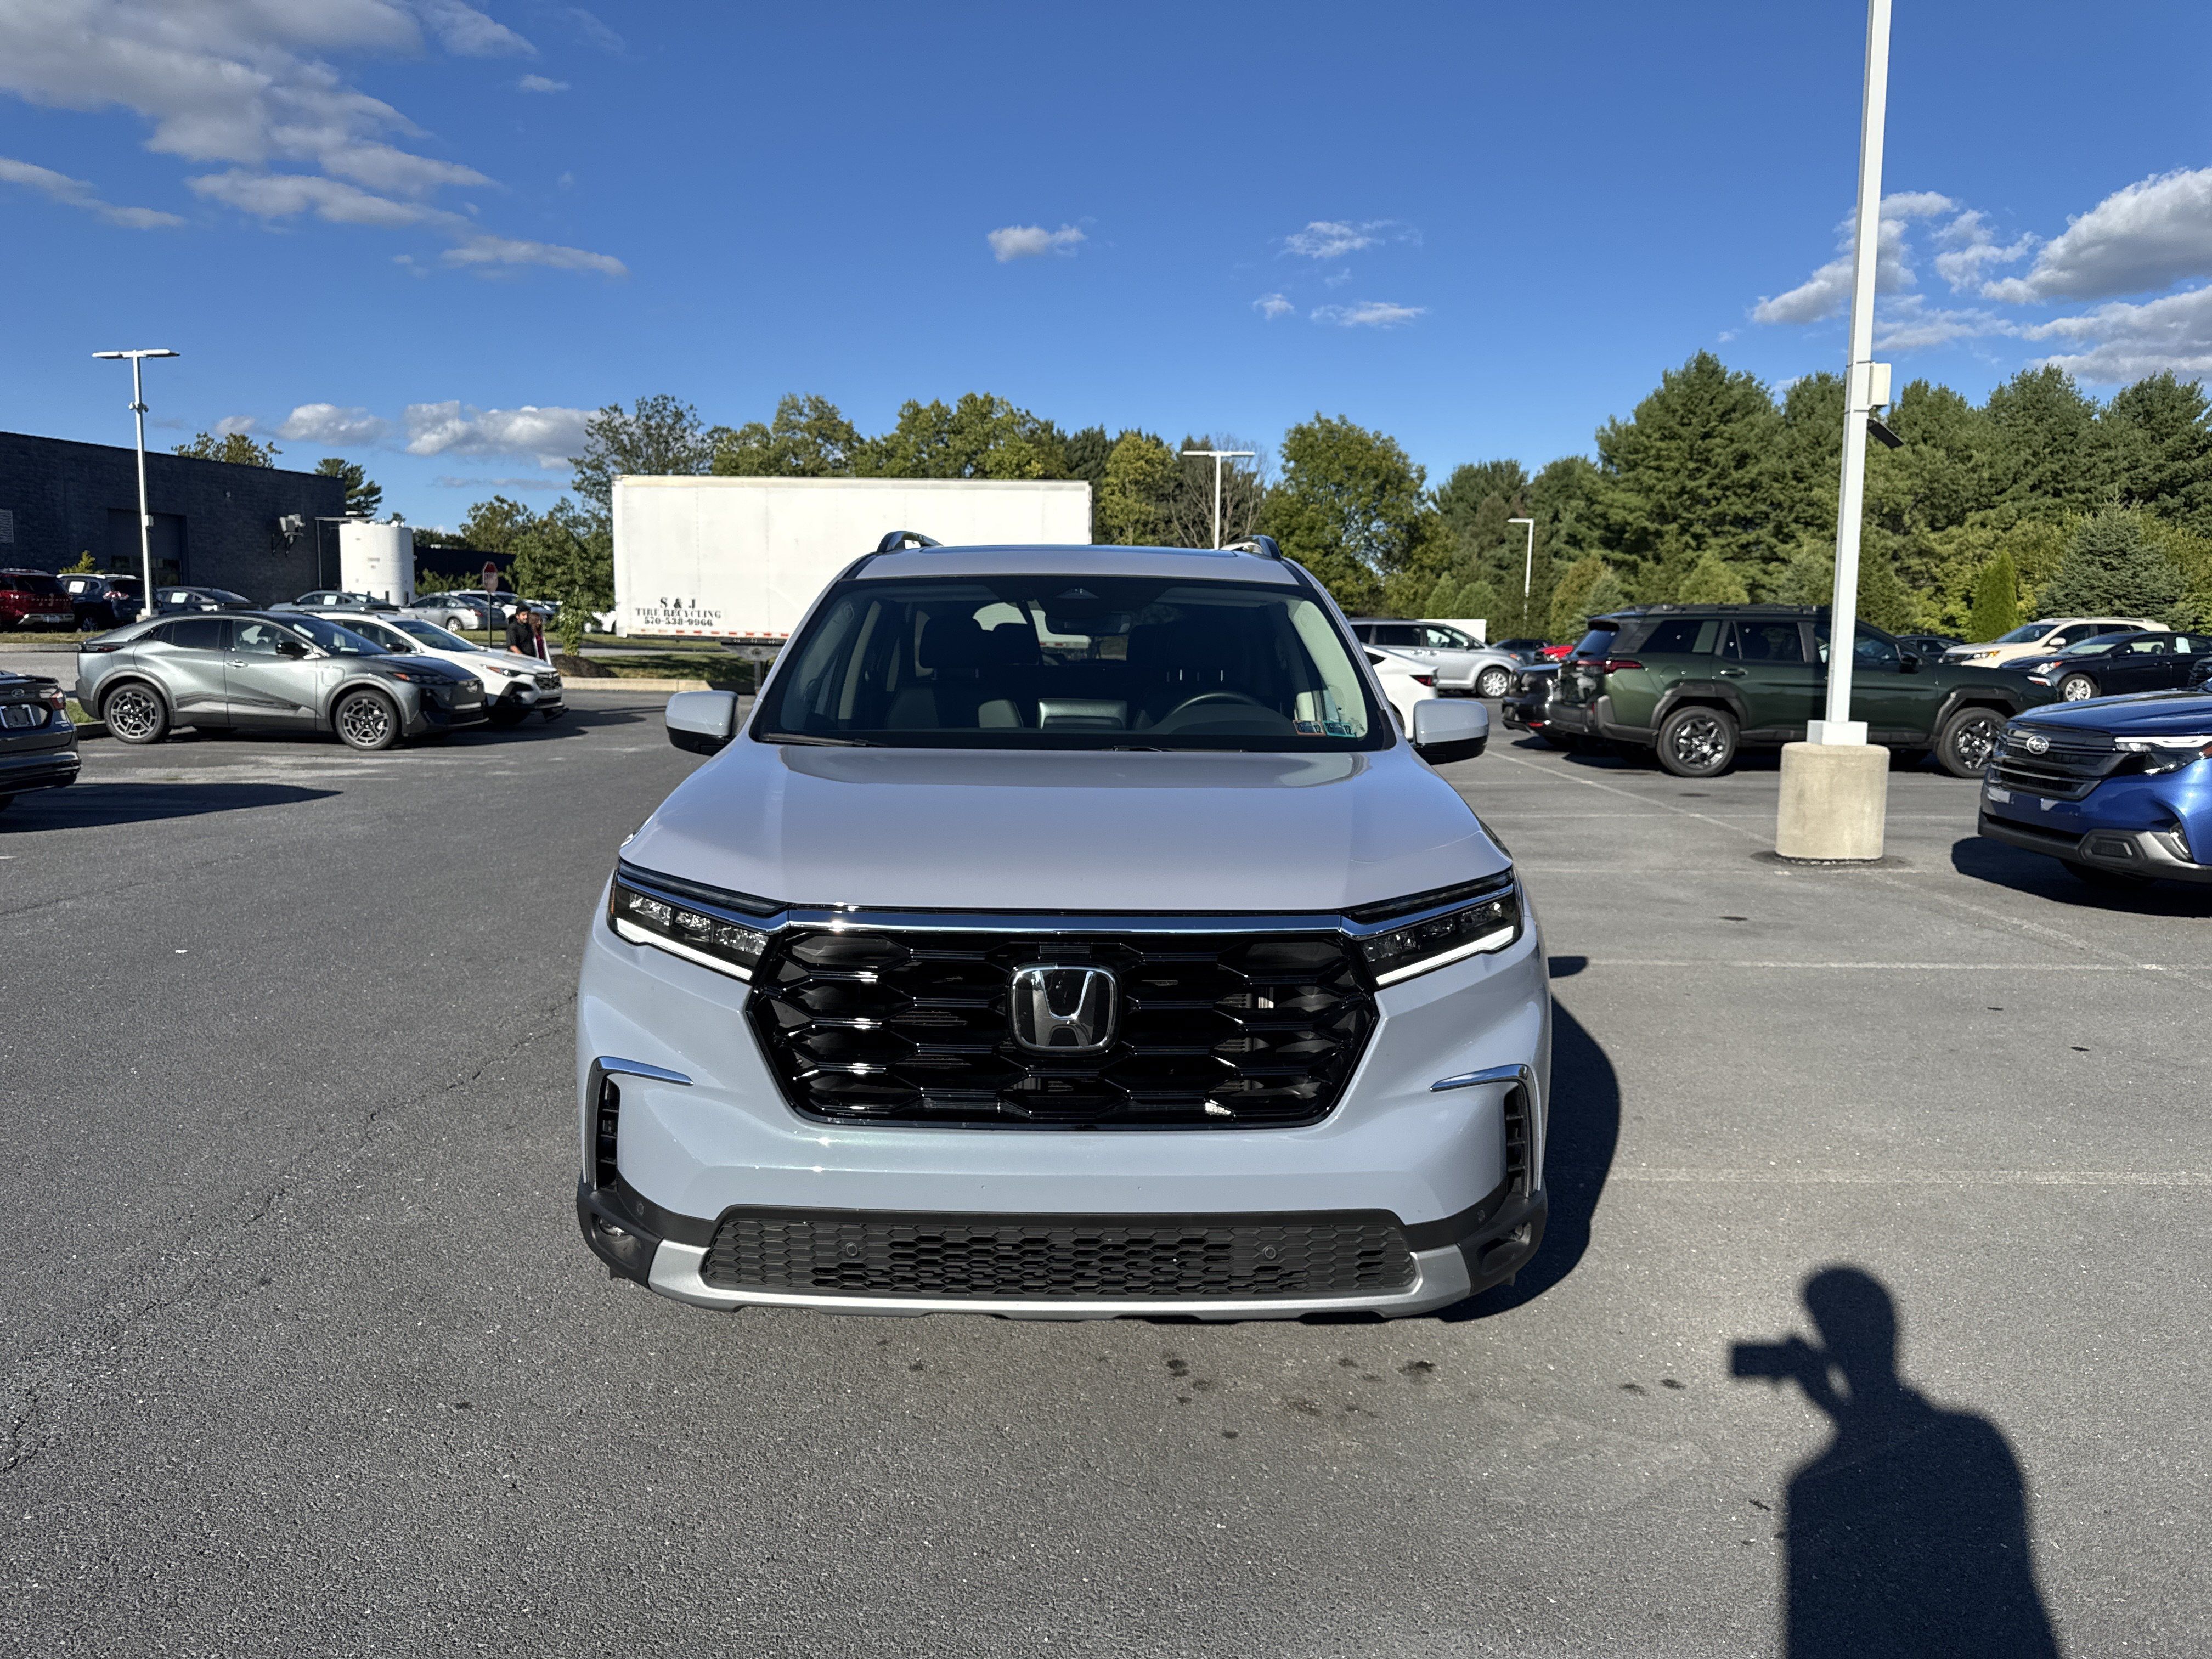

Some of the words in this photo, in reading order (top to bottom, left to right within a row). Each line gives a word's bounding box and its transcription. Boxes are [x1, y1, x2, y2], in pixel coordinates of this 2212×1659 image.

[660, 597, 668, 608] S
[674, 597, 682, 608] &
[688, 598, 696, 609] J
[635, 607, 660, 616] TIRE
[663, 609, 721, 618] RECYCLING
